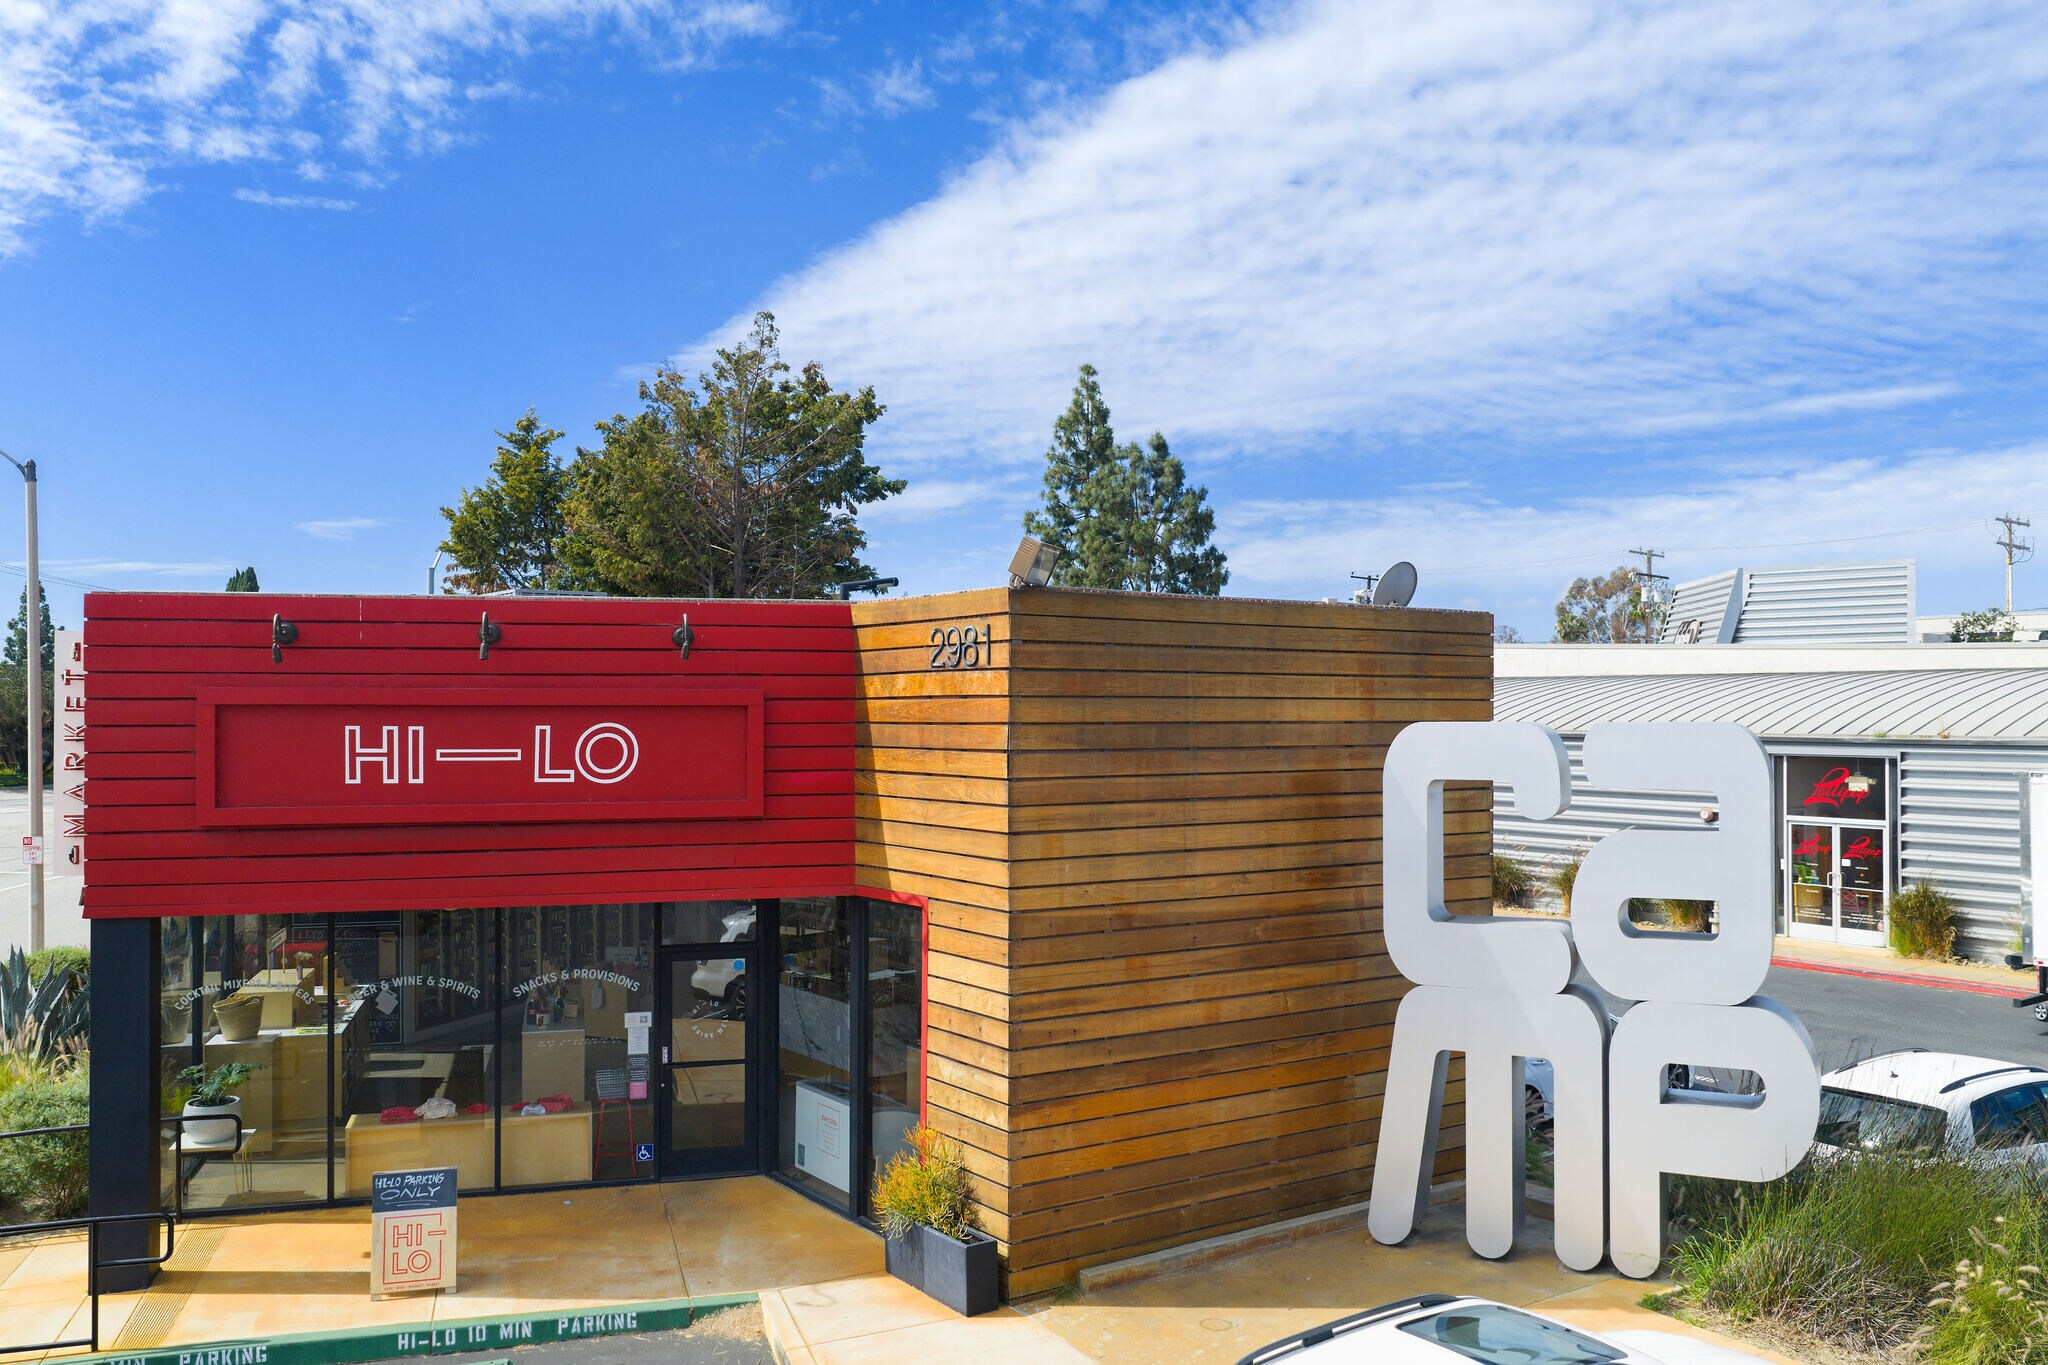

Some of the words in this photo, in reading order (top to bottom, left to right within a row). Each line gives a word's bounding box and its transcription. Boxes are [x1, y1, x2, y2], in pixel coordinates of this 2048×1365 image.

[930, 624, 991, 668] 2981
[63, 669, 86, 837] MARKET
[1803, 767, 1870, 808] Lollipop
[174, 983, 221, 1011] COCKTAIL
[223, 978, 262, 990] MIXERS
[347, 983, 378, 1003] BEER
[380, 980, 390, 990] &
[392, 975, 423, 987] WINE
[426, 976, 435, 986] &
[438, 977, 481, 999] SPIRITS
[512, 971, 558, 997] SNACKS
[561, 968, 570, 980] &
[573, 968, 641, 992] PROVISIONS
[380, 1186, 440, 1200] ONLY
[403, 1173, 445, 1186] PARKING
[392, 1249, 432, 1275] LO
[398, 1328, 456, 1350] HI-LO
[468, 1325, 487, 1343] 10
[499, 1321, 533, 1340] MIN
[557, 1311, 637, 1335] PARKING
[179, 1345, 267, 1365] PARKING
